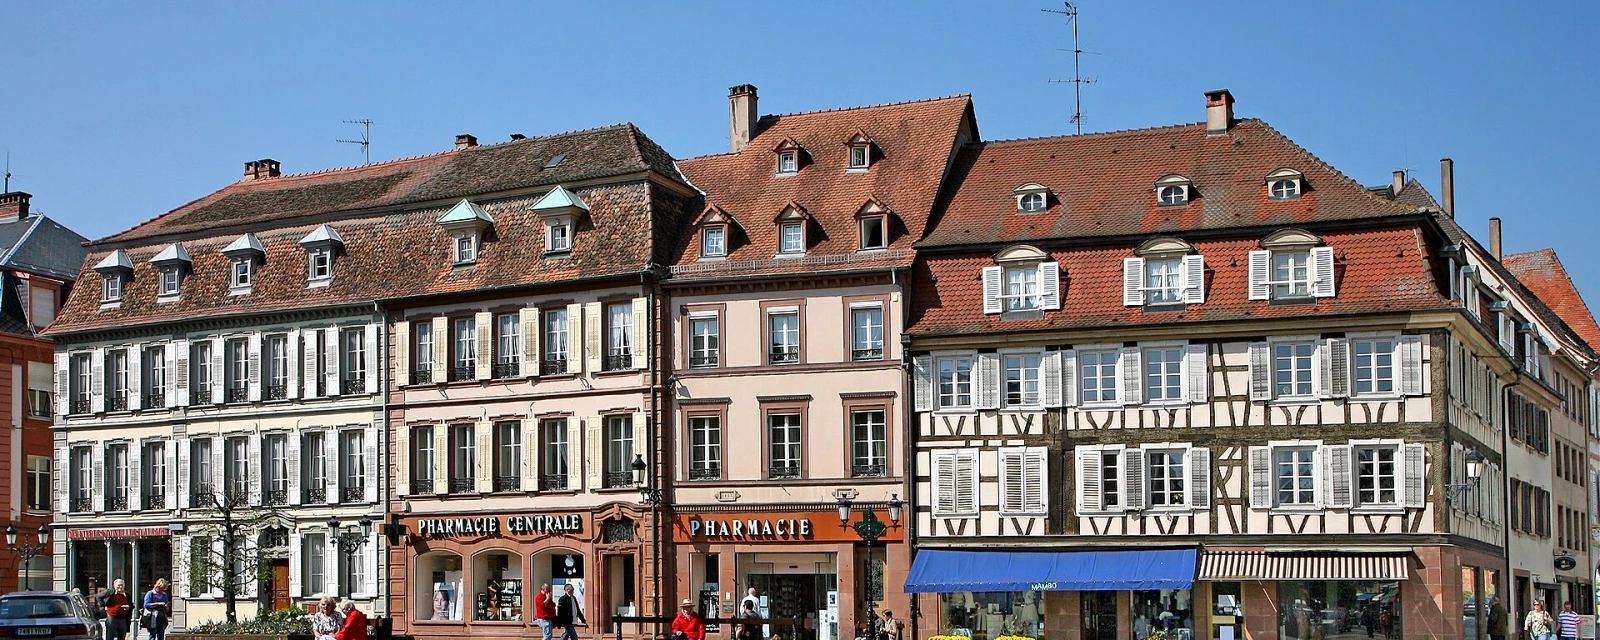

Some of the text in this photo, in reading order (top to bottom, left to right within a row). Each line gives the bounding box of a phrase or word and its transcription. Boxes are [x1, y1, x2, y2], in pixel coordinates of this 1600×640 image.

[418, 515, 580, 534] PHARMACIE CENTRALE
[691, 519, 810, 536] PHARMACIE
[1031, 582, 1057, 590] MAMBO
